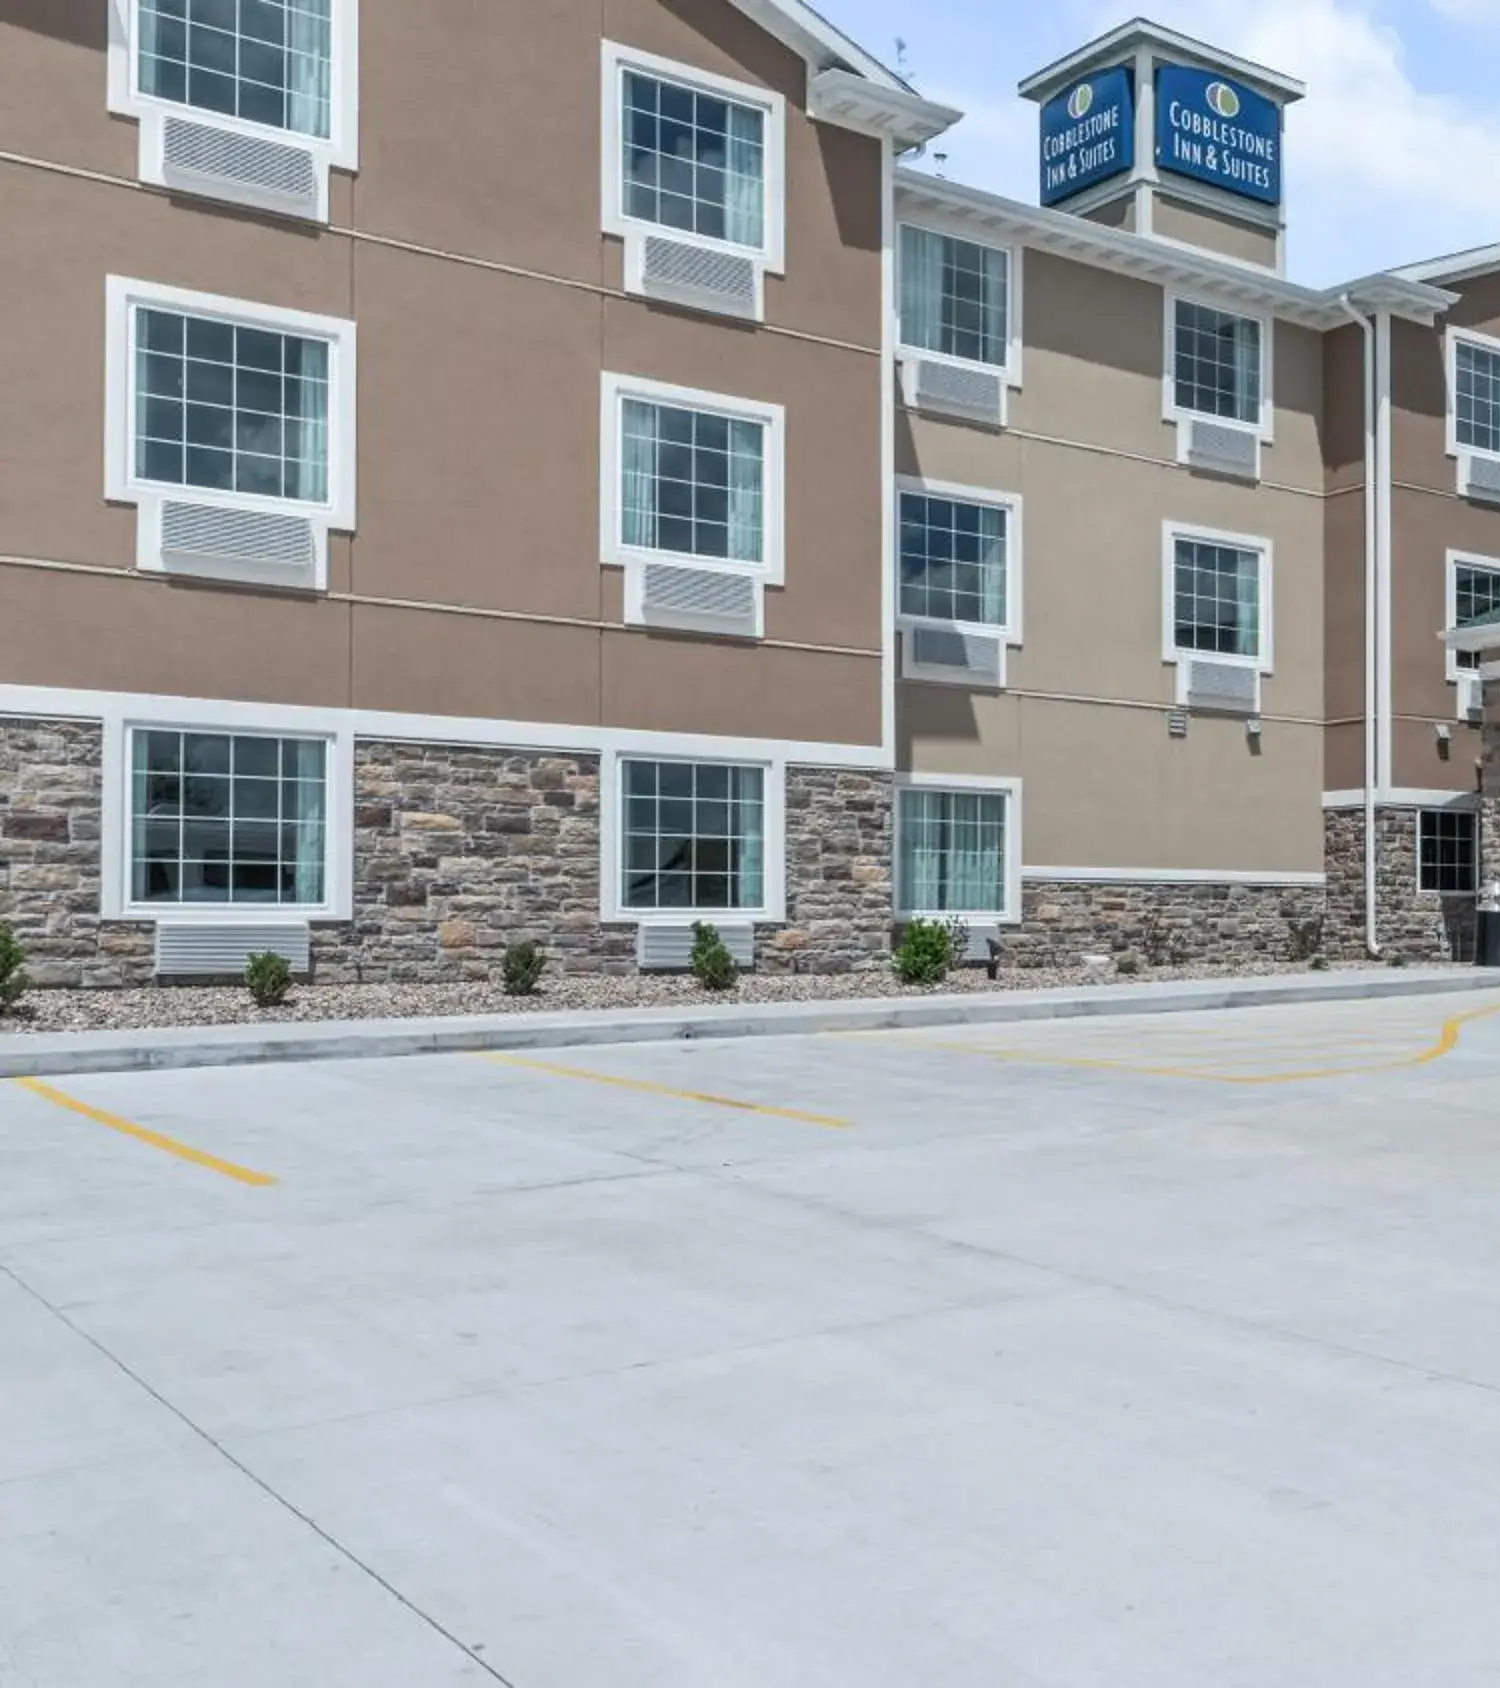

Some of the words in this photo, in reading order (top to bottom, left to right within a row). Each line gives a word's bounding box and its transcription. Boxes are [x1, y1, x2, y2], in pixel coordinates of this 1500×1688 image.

[1067, 153, 1077, 179] &
[1079, 137, 1115, 174] SUITES
[1169, 100, 1274, 161] COBBLESTONE
[1174, 131, 1202, 165] INN
[1205, 143, 1217, 171] &
[1222, 149, 1269, 188] SUITES
